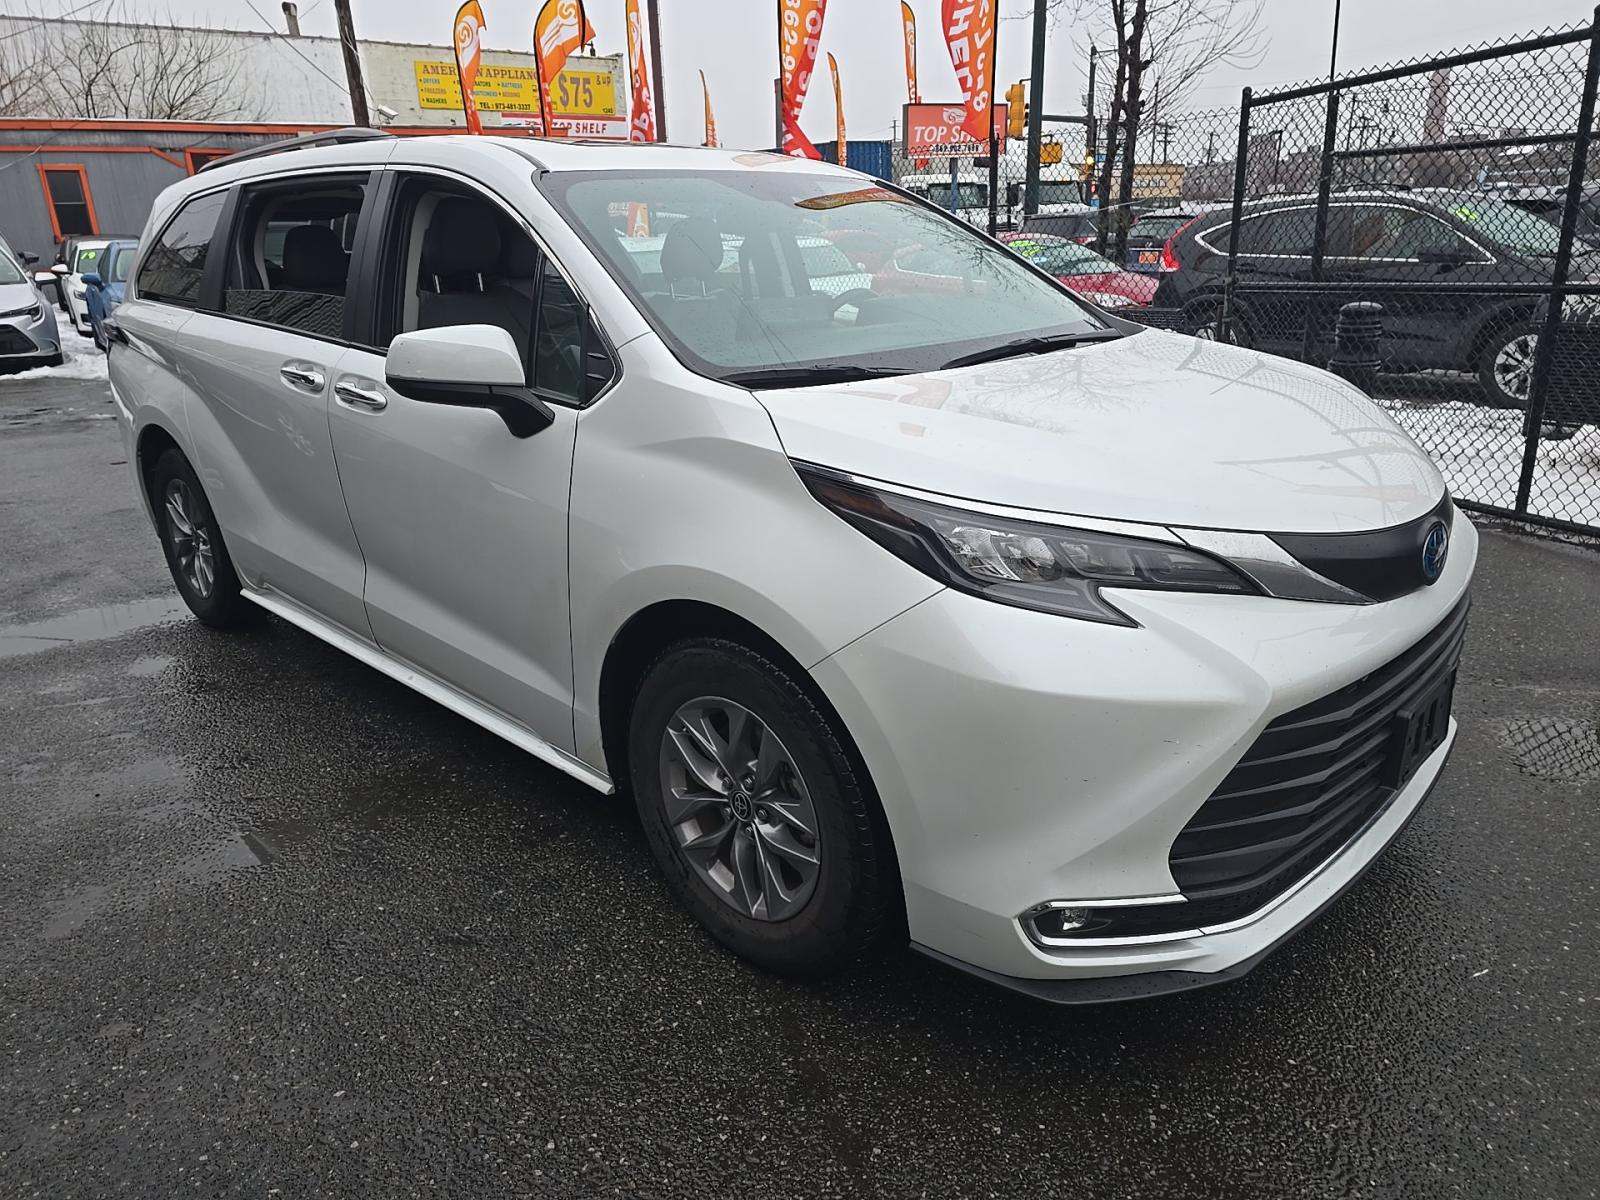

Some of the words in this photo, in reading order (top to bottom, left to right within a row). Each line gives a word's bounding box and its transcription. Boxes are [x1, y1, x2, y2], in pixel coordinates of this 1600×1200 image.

[422, 64, 483, 77] AMERN
[558, 72, 593, 110] $75
[575, 122, 607, 134] SHELF
[914, 126, 947, 143] TOP
